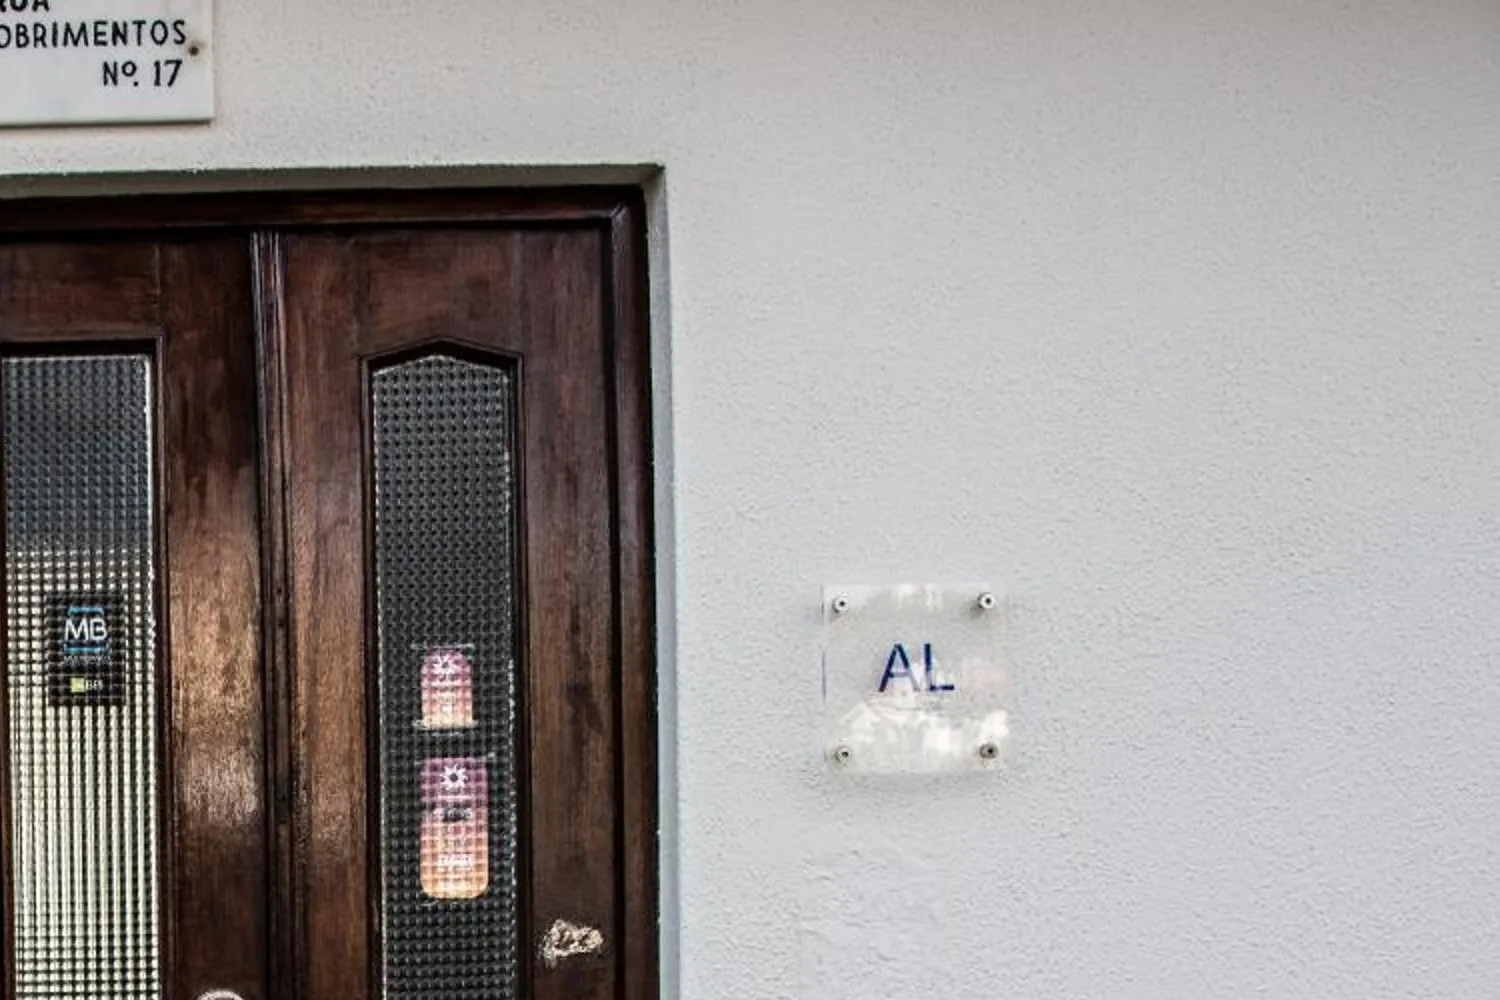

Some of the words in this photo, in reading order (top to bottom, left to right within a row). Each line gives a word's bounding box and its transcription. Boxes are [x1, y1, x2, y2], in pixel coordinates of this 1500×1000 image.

[153, 60, 183, 88] 17
[64, 618, 108, 641] MB
[877, 642, 955, 692] AL
